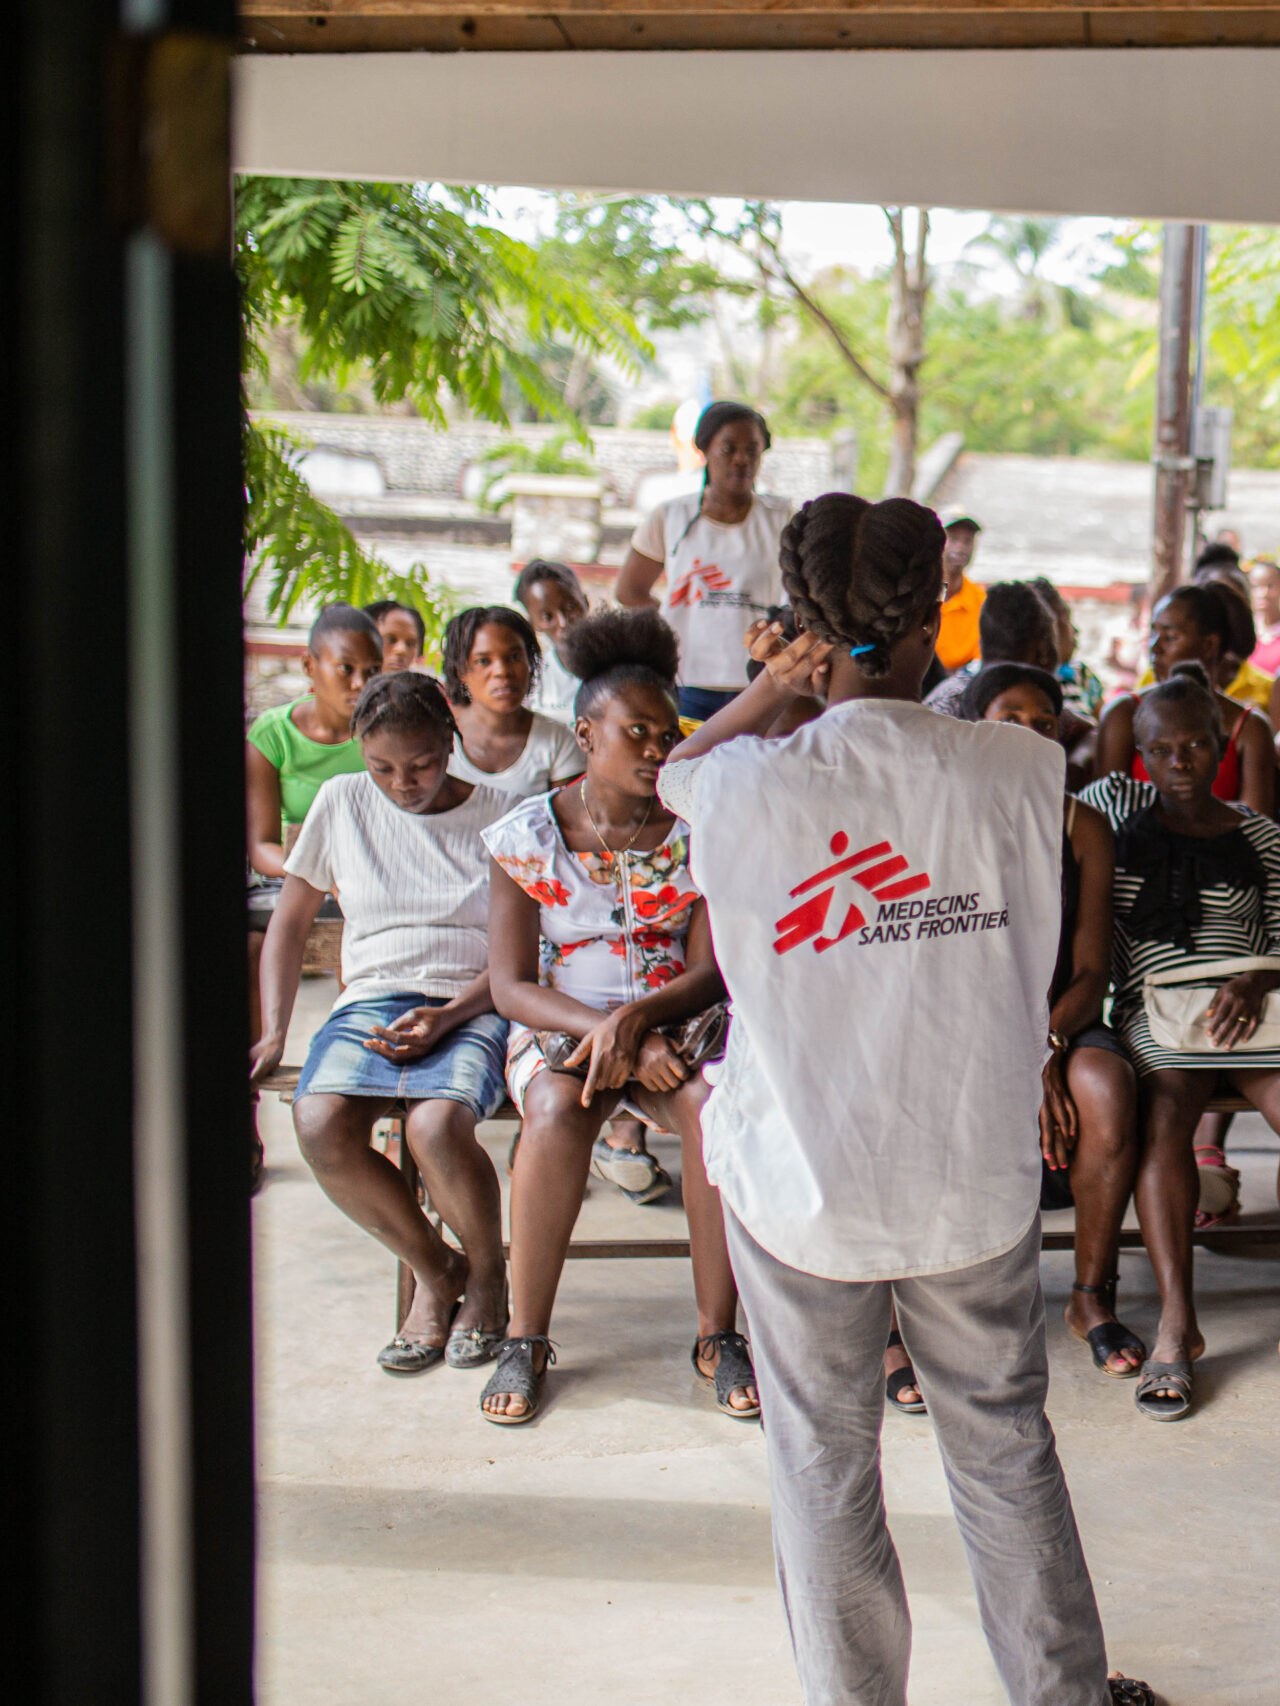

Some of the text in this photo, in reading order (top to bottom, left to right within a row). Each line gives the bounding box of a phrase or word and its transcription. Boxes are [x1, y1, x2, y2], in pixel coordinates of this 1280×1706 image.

[857, 903, 1010, 946] SANS FRONTIER
[876, 892, 980, 923] MEDECINS
